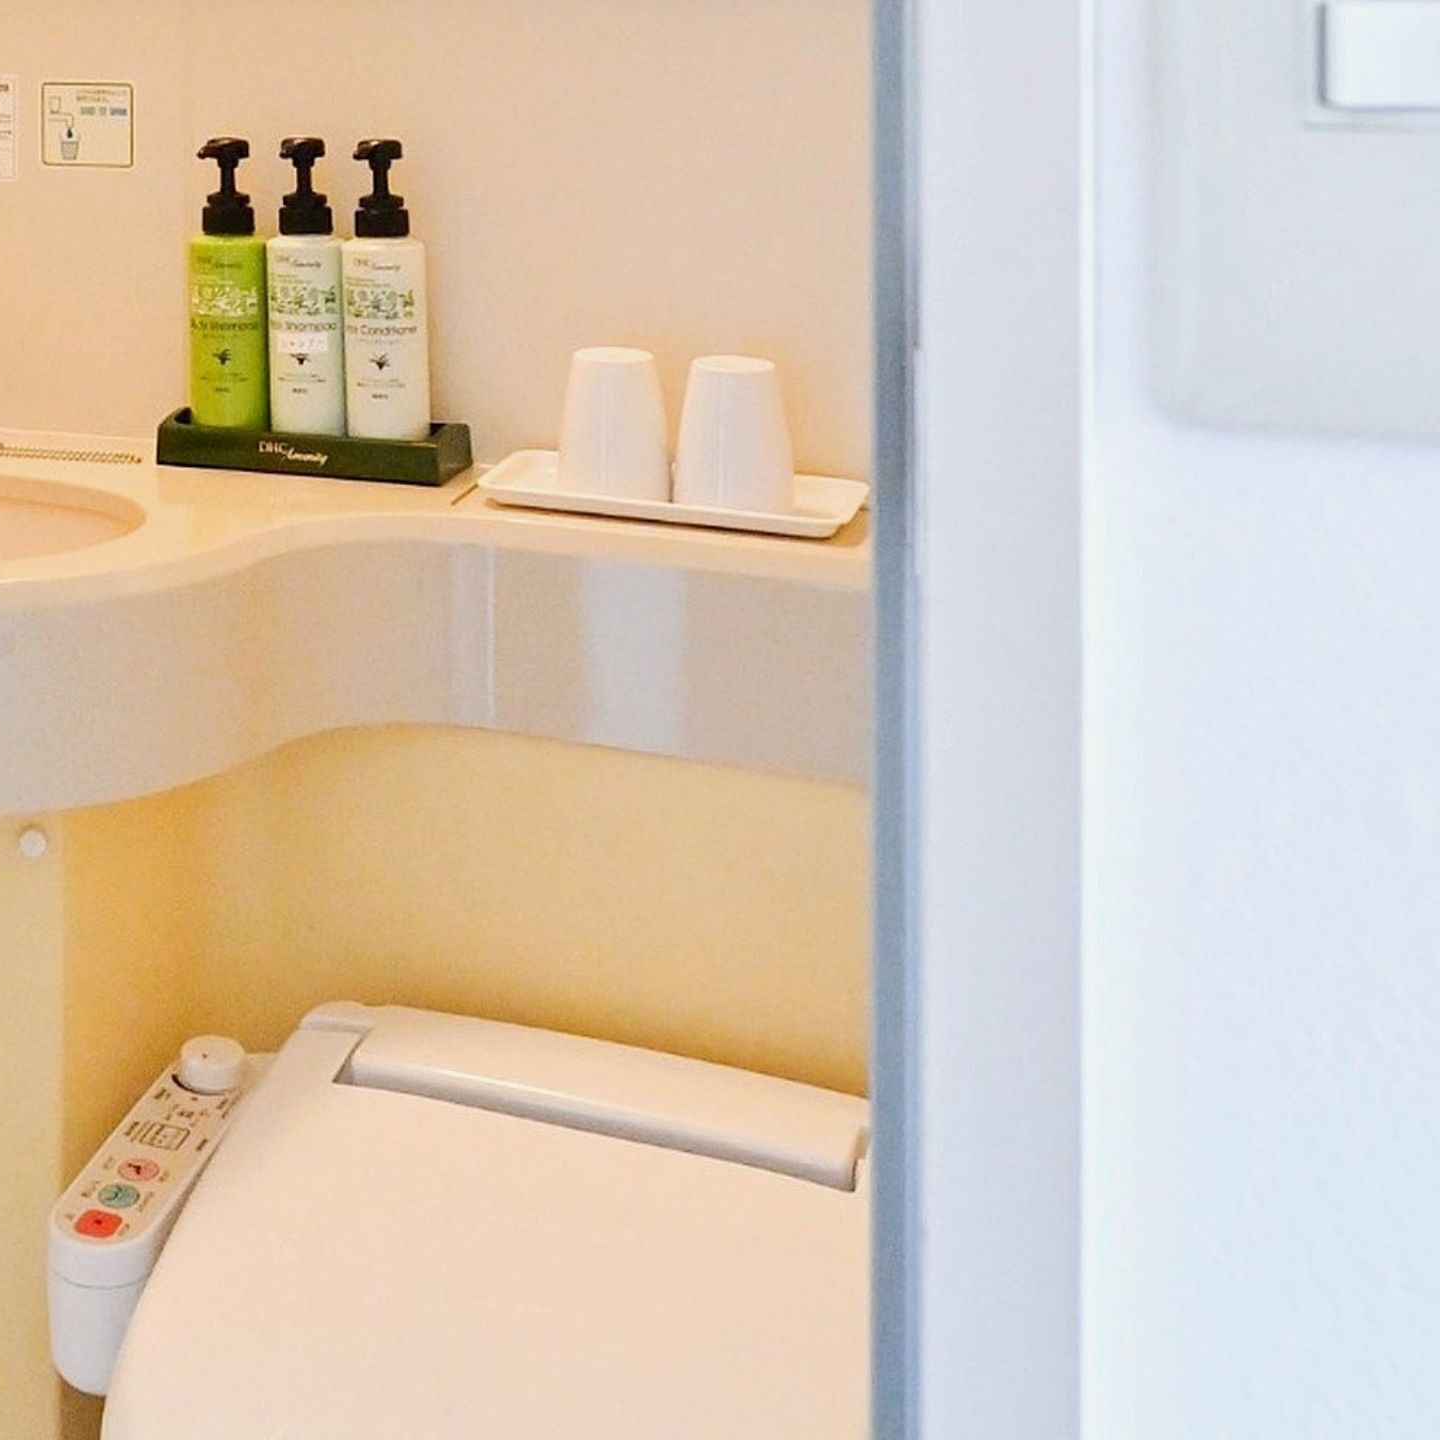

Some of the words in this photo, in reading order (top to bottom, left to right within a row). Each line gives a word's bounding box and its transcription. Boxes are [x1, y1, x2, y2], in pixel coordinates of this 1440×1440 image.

[285, 321, 337, 332] Shampoo
[360, 324, 418, 337] Conditioner
[259, 440, 288, 455] DHC
